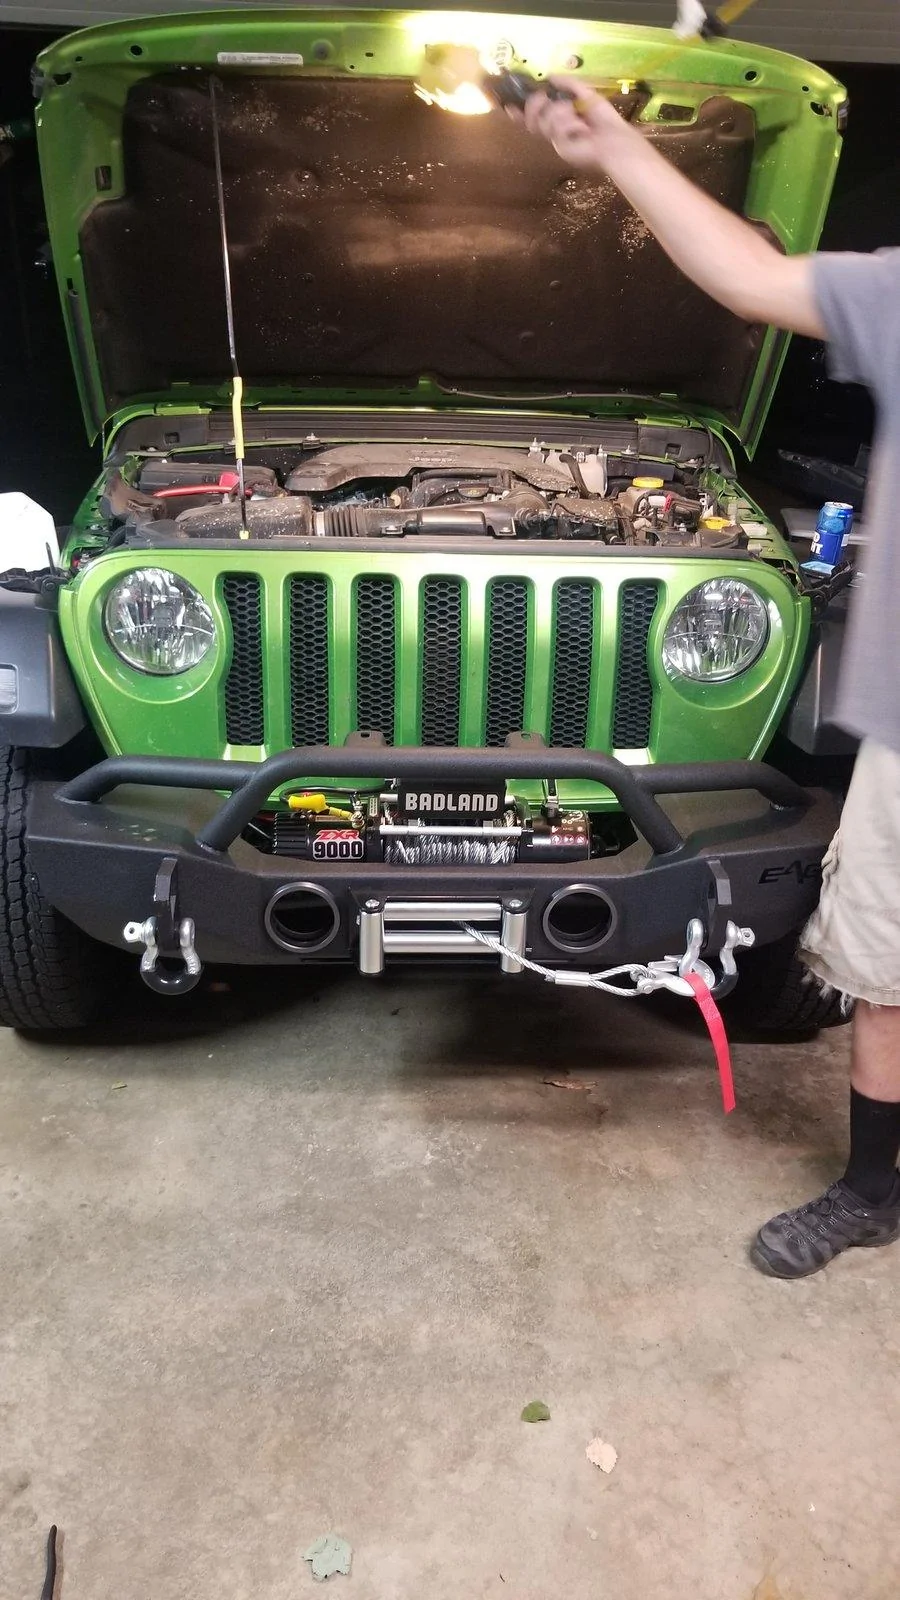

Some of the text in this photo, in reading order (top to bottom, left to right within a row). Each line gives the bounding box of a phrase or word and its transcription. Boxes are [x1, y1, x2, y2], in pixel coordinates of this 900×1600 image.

[405, 793, 499, 812] BADLAND
[316, 829, 360, 841] ZXR
[314, 841, 364, 859] 9000
